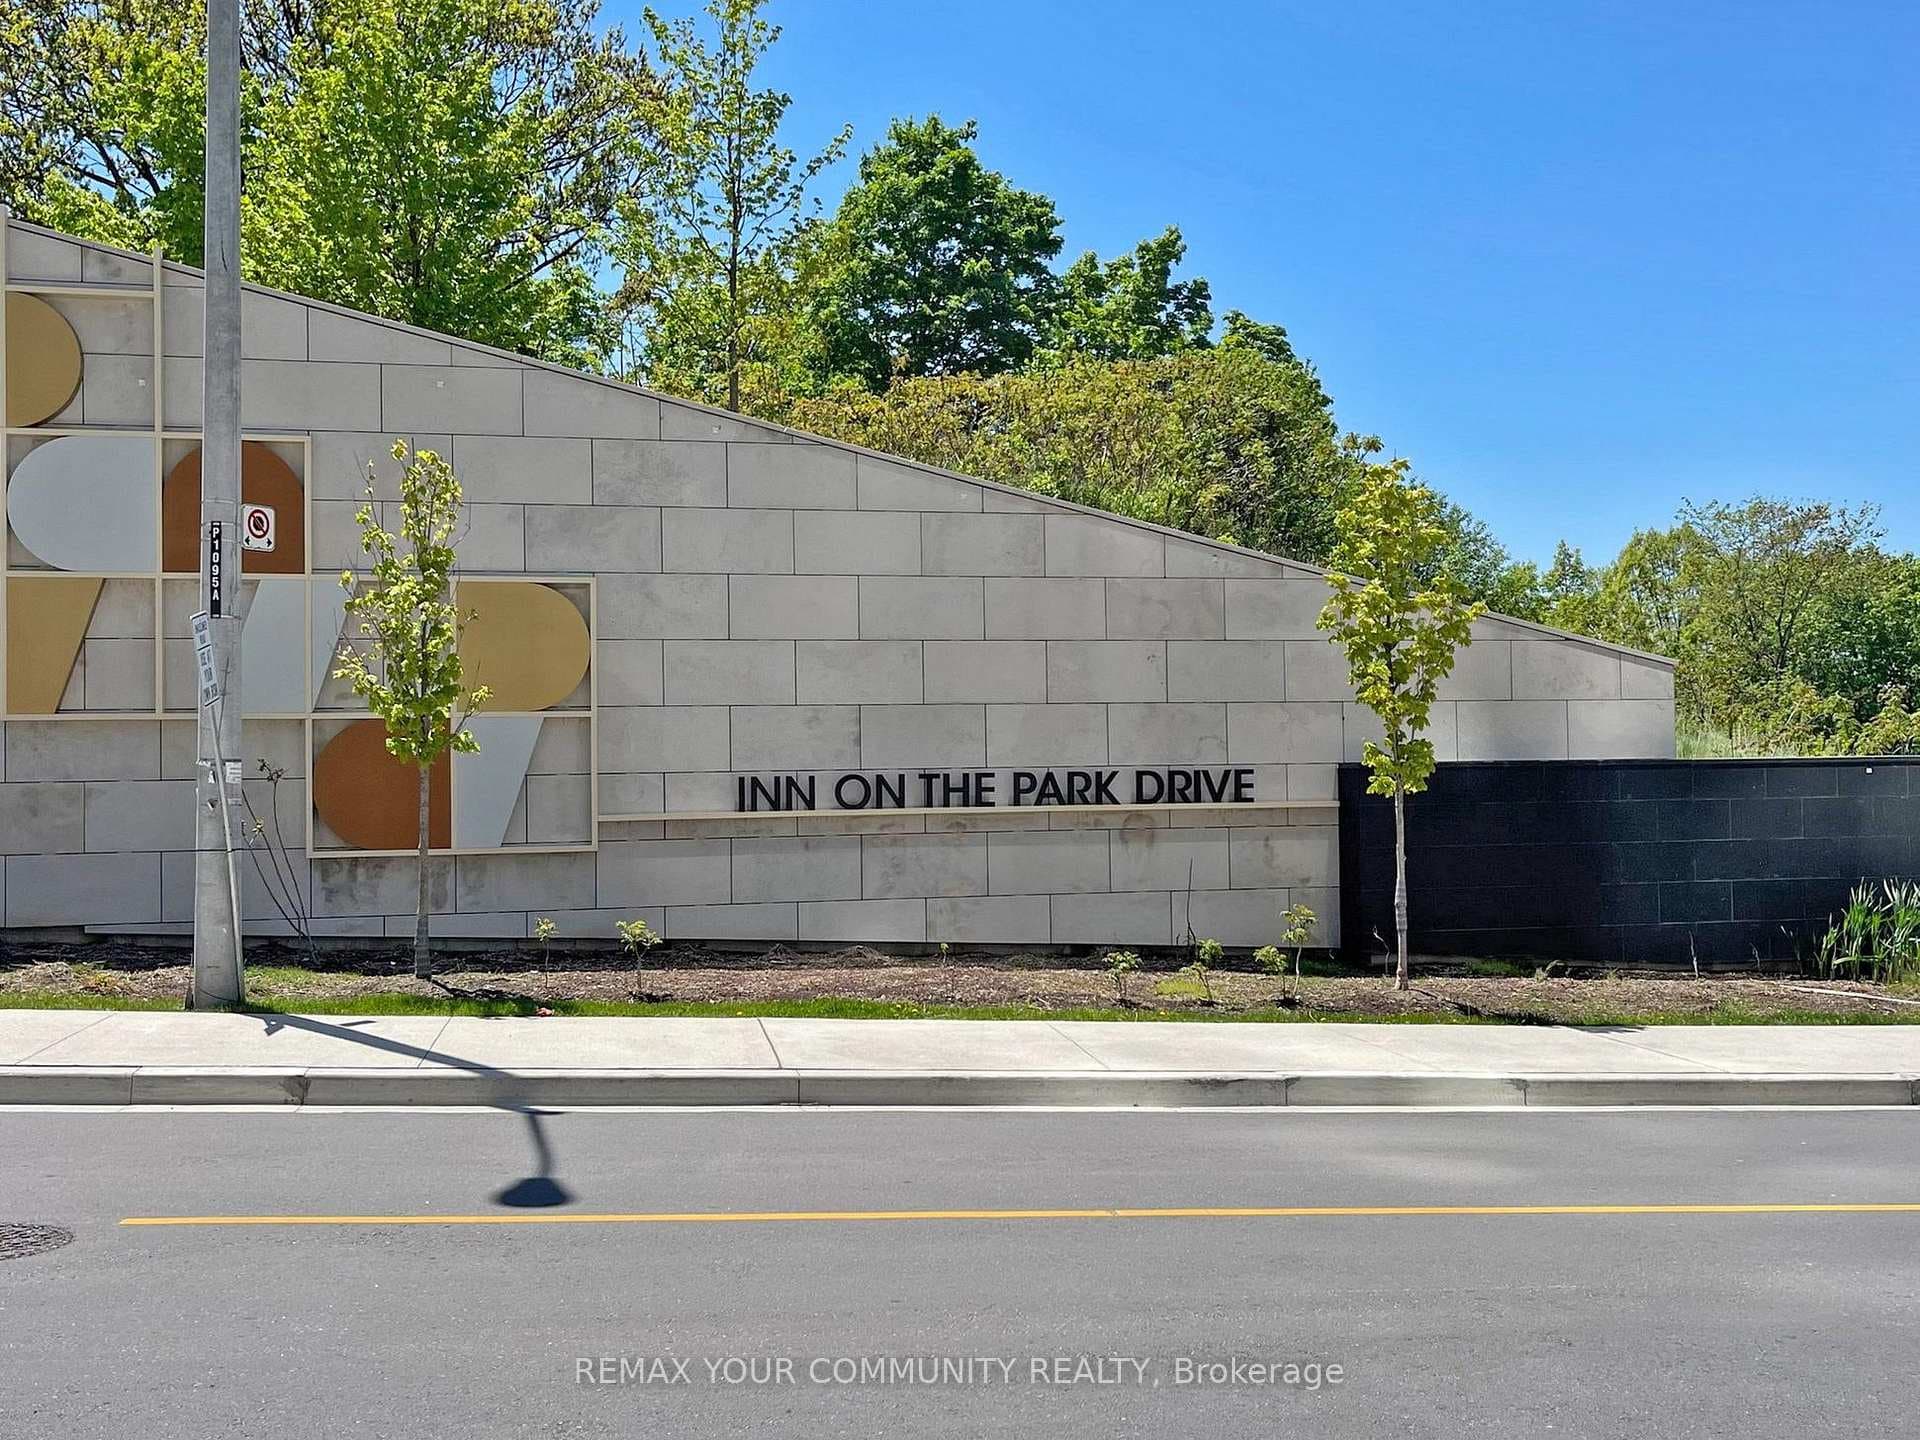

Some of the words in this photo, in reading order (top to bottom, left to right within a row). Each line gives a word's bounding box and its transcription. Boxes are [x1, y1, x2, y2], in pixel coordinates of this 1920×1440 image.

[211, 527, 220, 601] P1095A
[738, 775, 815, 811] INN
[834, 773, 905, 809] ON
[919, 772, 996, 808] THE
[1013, 771, 1121, 806] PARK
[1135, 769, 1255, 804] DRIVE
